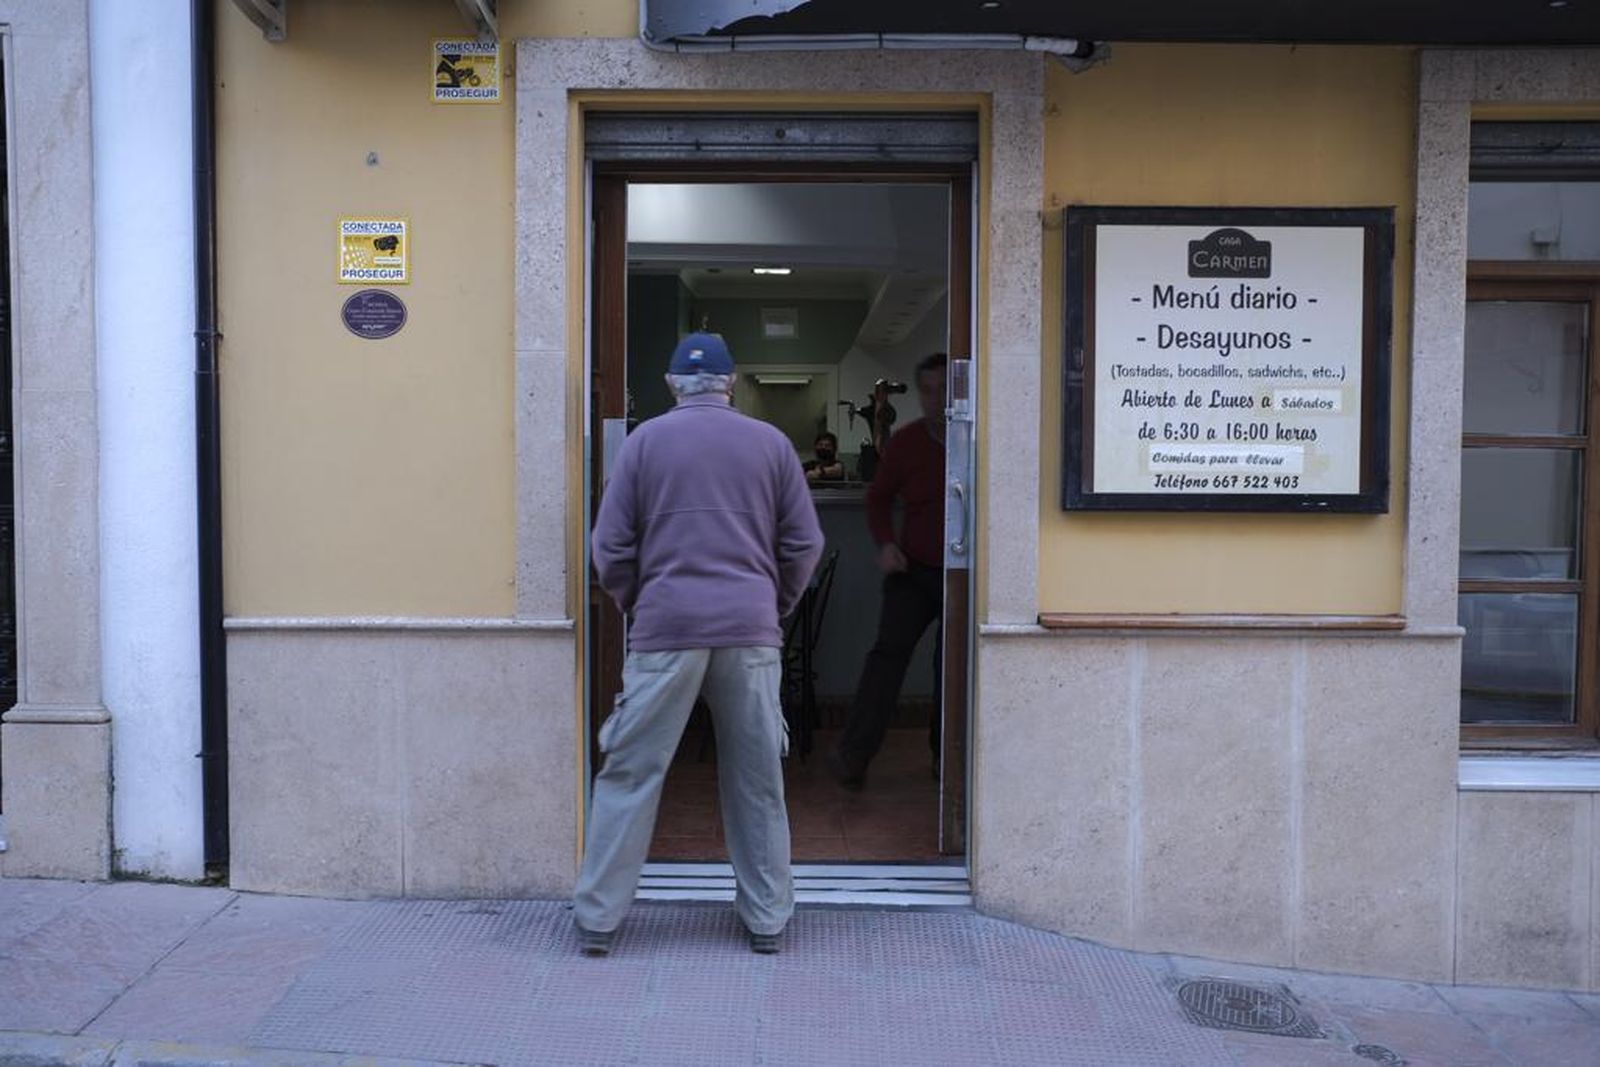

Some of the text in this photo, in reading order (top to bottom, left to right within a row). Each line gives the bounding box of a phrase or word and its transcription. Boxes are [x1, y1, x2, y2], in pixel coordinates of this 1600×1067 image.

[436, 42, 496, 51] CONECTADA
[436, 89, 498, 98] PROSEGUR
[343, 222, 403, 230] CONECTADA
[342, 269, 403, 278] PROSEGUR
[1152, 284, 1220, 310] Menú
[1230, 283, 1298, 310] diario
[1157, 324, 1292, 357] Desayunos
[1110, 364, 1347, 381] (Tostadas, bocadillos, sadwichs, etc..)
[1121, 389, 1334, 411] Abierto de Lunes a Sábados
[1138, 422, 1318, 442] de 6:30 a 16:00 horas
[1152, 452, 1285, 466] Comidas para llevar
[1154, 474, 1299, 491] Teléfono 667 522 403
